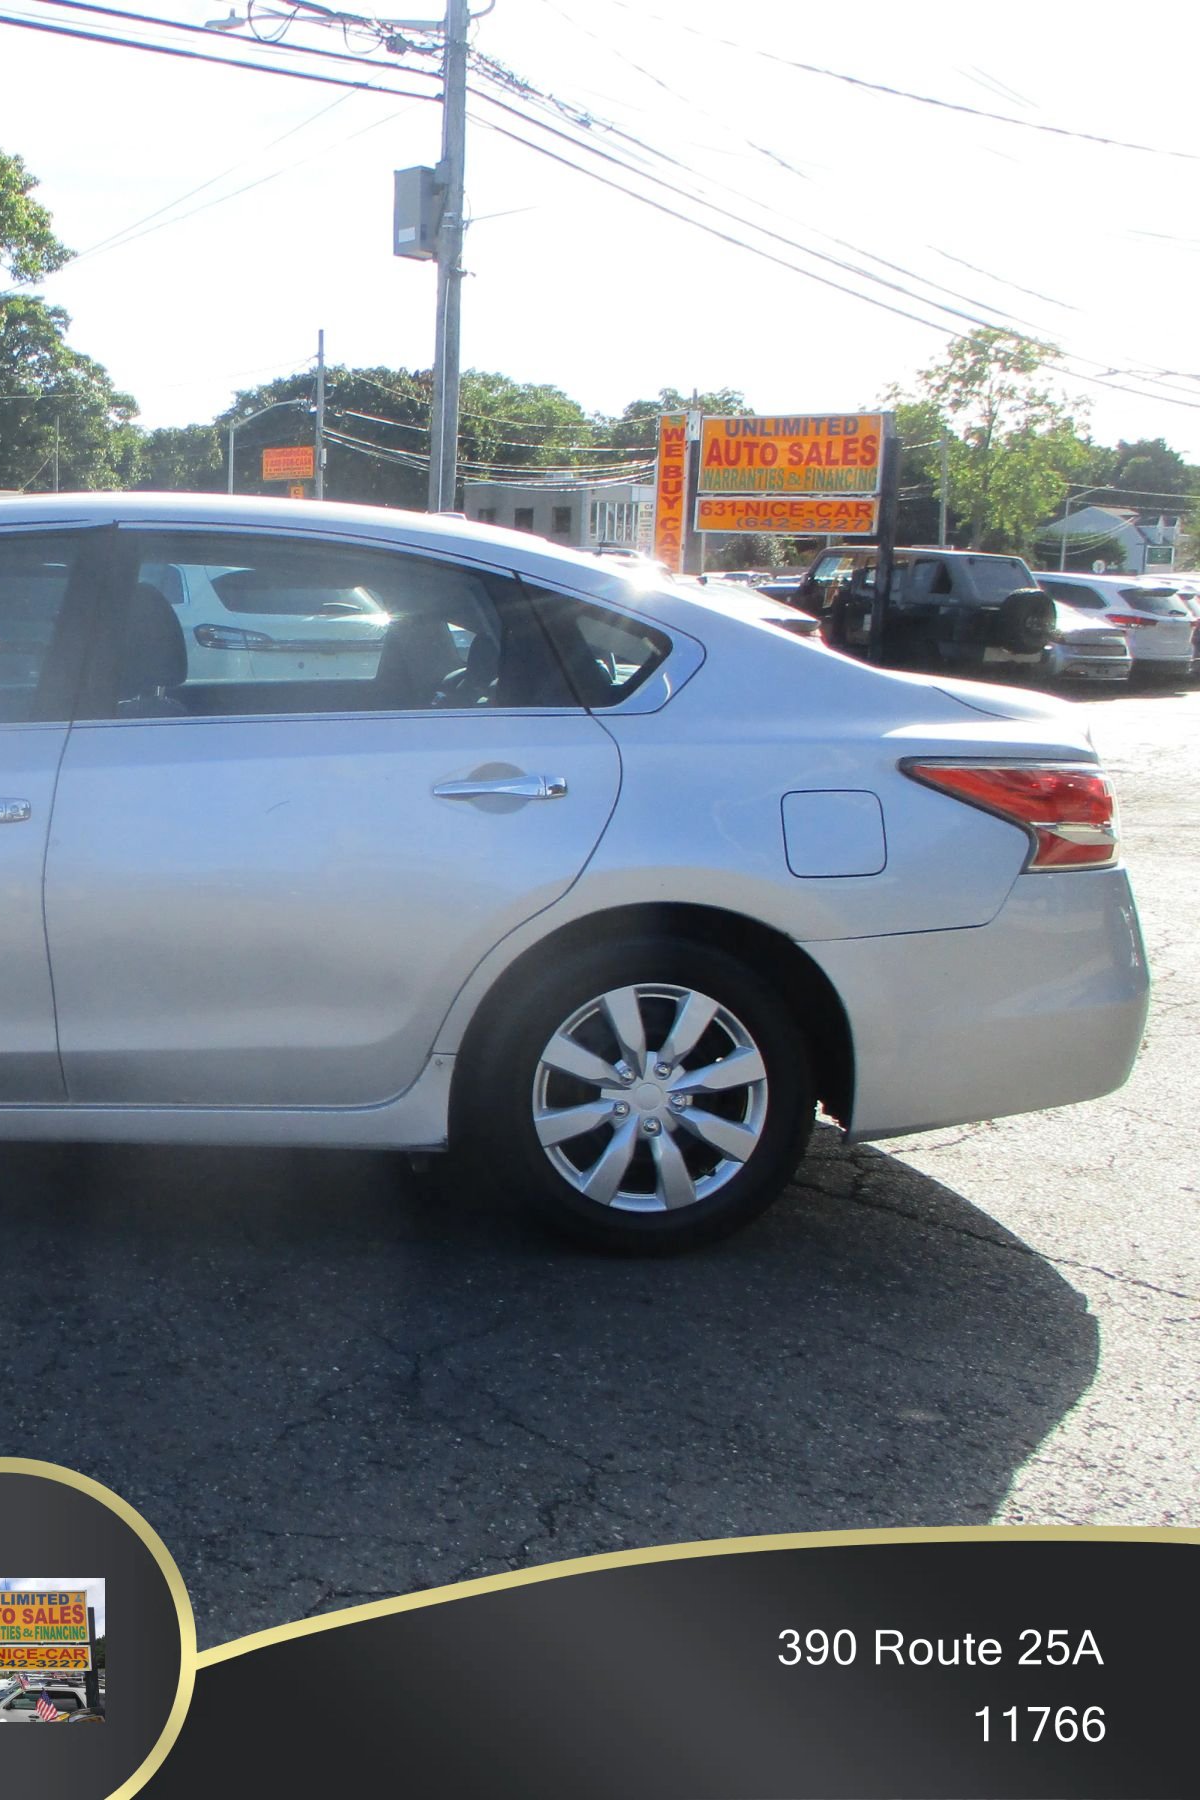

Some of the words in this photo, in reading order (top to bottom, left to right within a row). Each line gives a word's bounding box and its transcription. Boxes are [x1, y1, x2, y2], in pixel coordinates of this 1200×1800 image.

[724, 417, 859, 437] UNLIMITED
[663, 428, 685, 457] WE
[704, 438, 779, 467] AUTO
[787, 435, 878, 466] SALES
[661, 465, 683, 509] BUY
[703, 468, 785, 489] WARRANTIES
[785, 472, 800, 486] &
[804, 467, 878, 489] FINANCING
[700, 502, 873, 518] 631-NICE-CAR
[736, 518, 874, 530] (642-3227)
